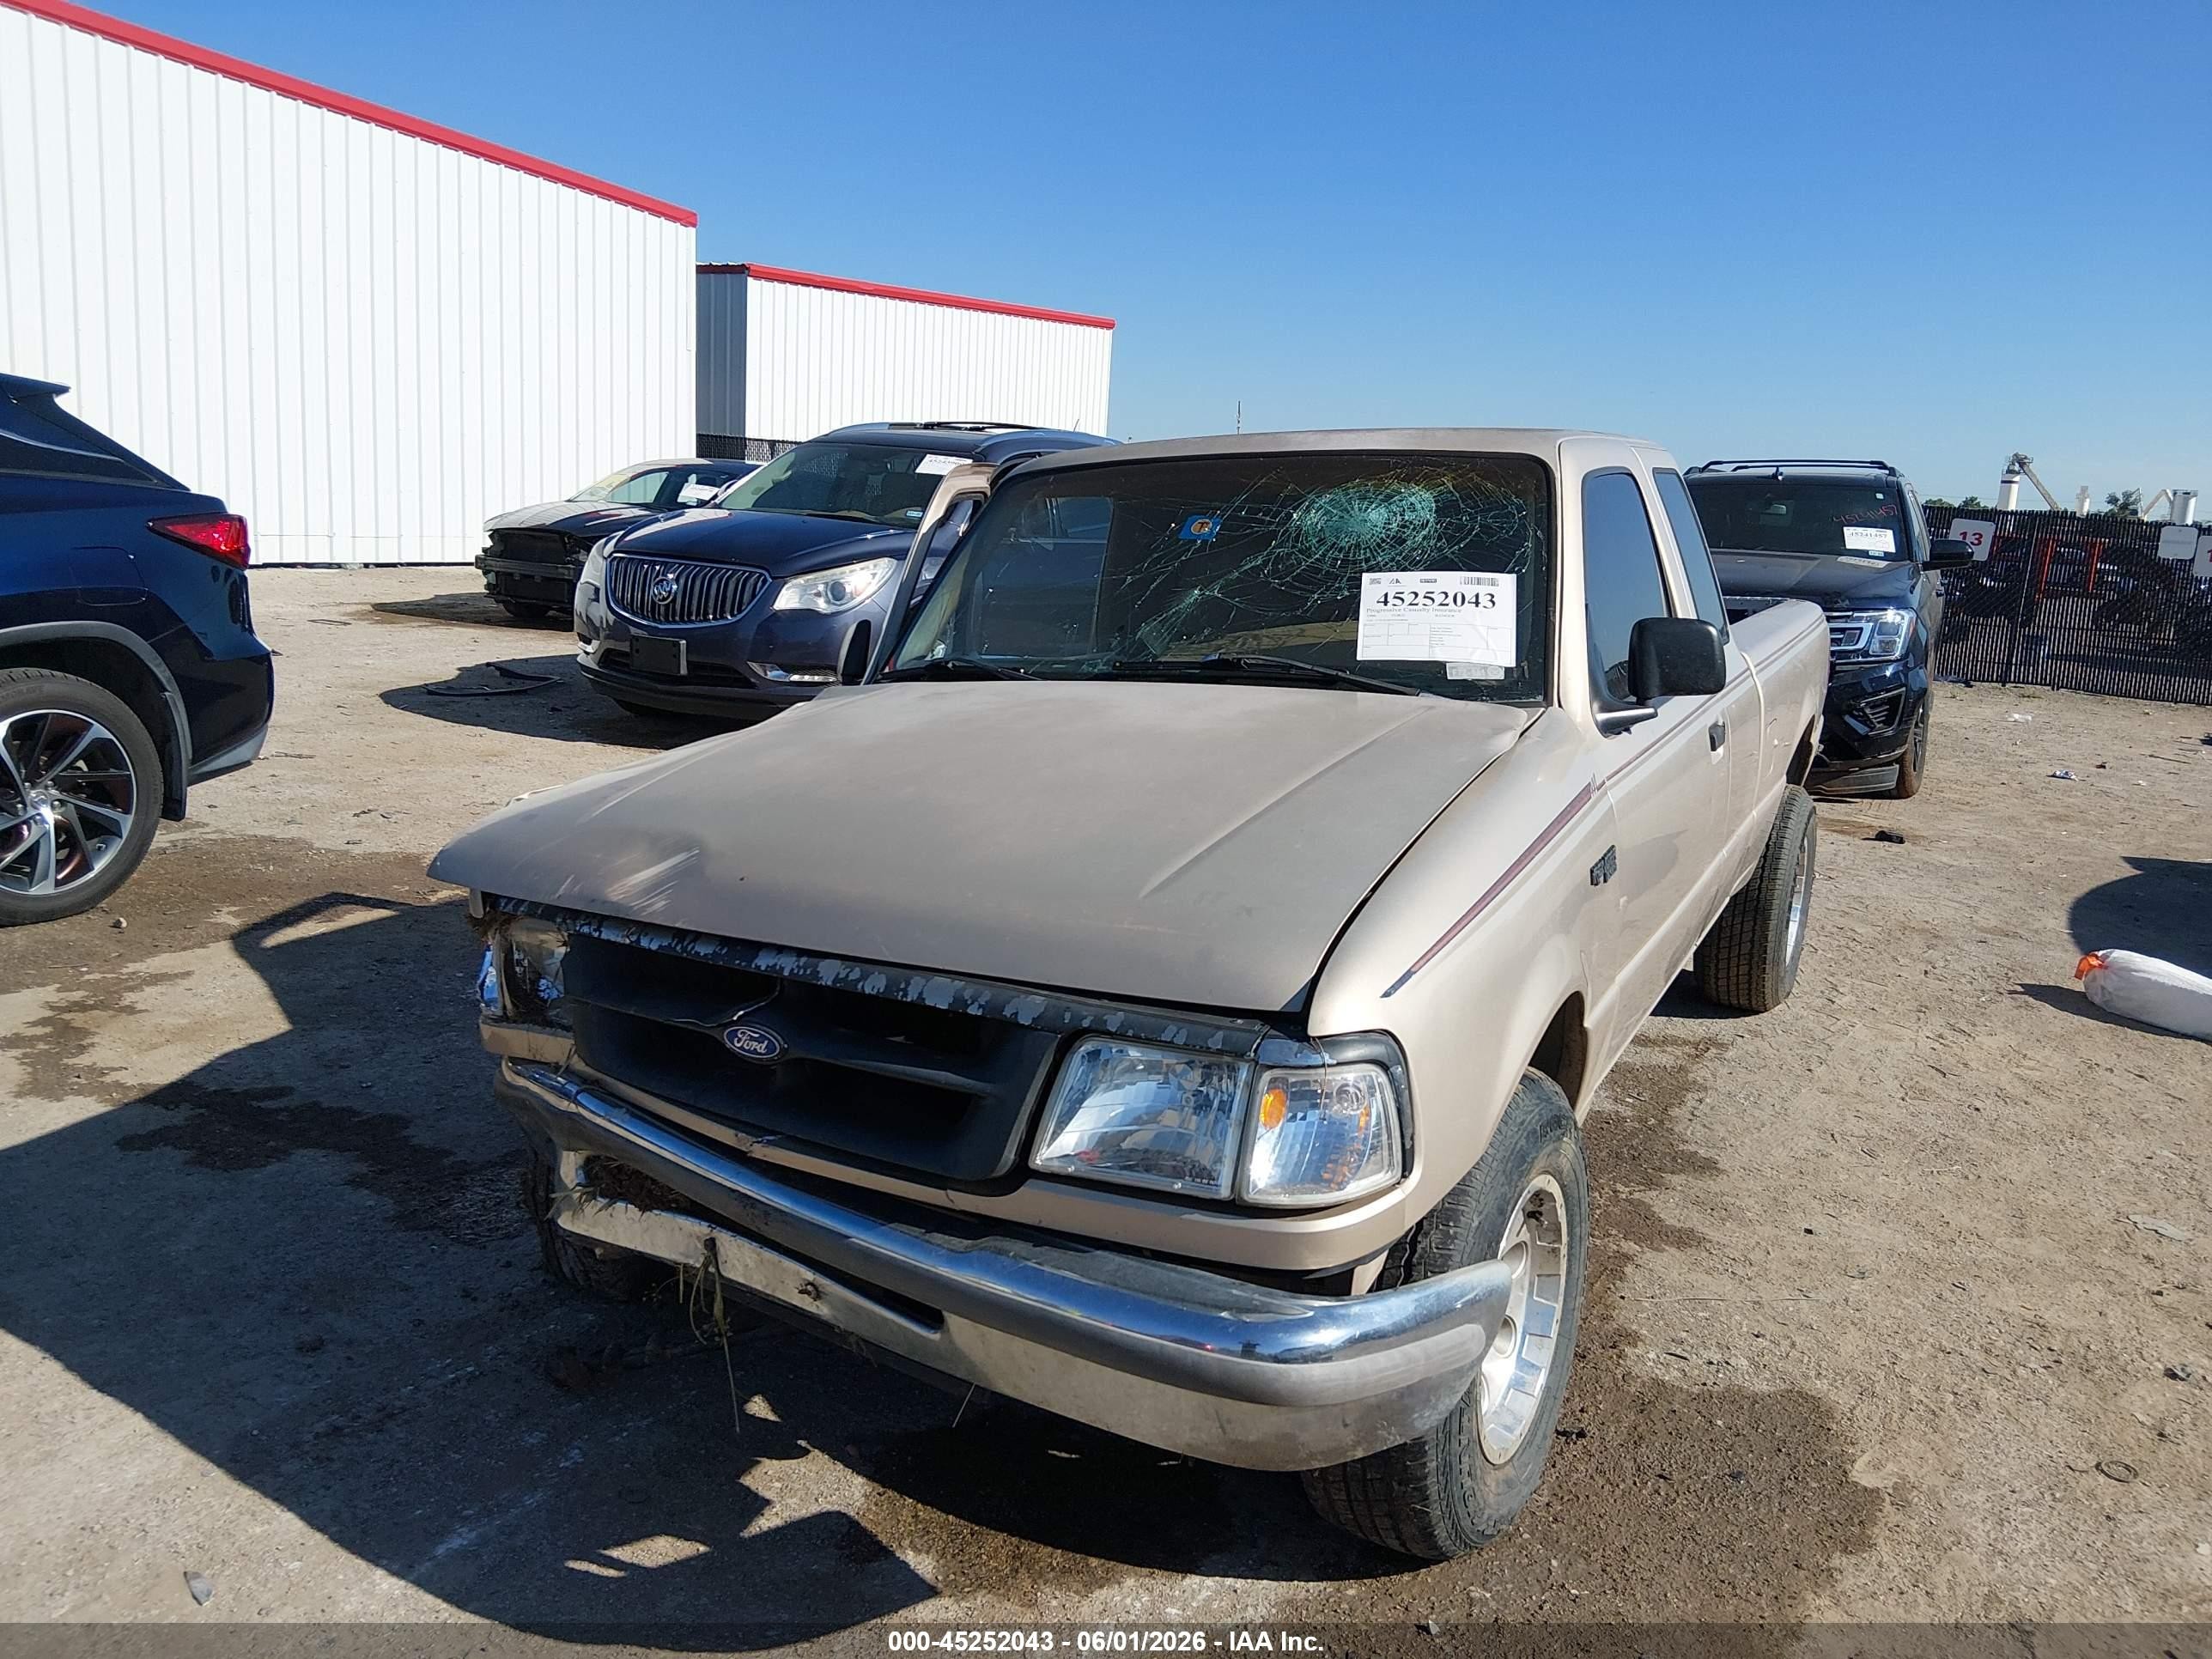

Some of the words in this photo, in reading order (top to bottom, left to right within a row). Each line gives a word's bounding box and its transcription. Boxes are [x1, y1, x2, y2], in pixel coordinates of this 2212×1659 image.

[1960, 531, 1984, 546] 13
[1376, 591, 1496, 609] 45252043
[733, 1029, 769, 1054] Ford
